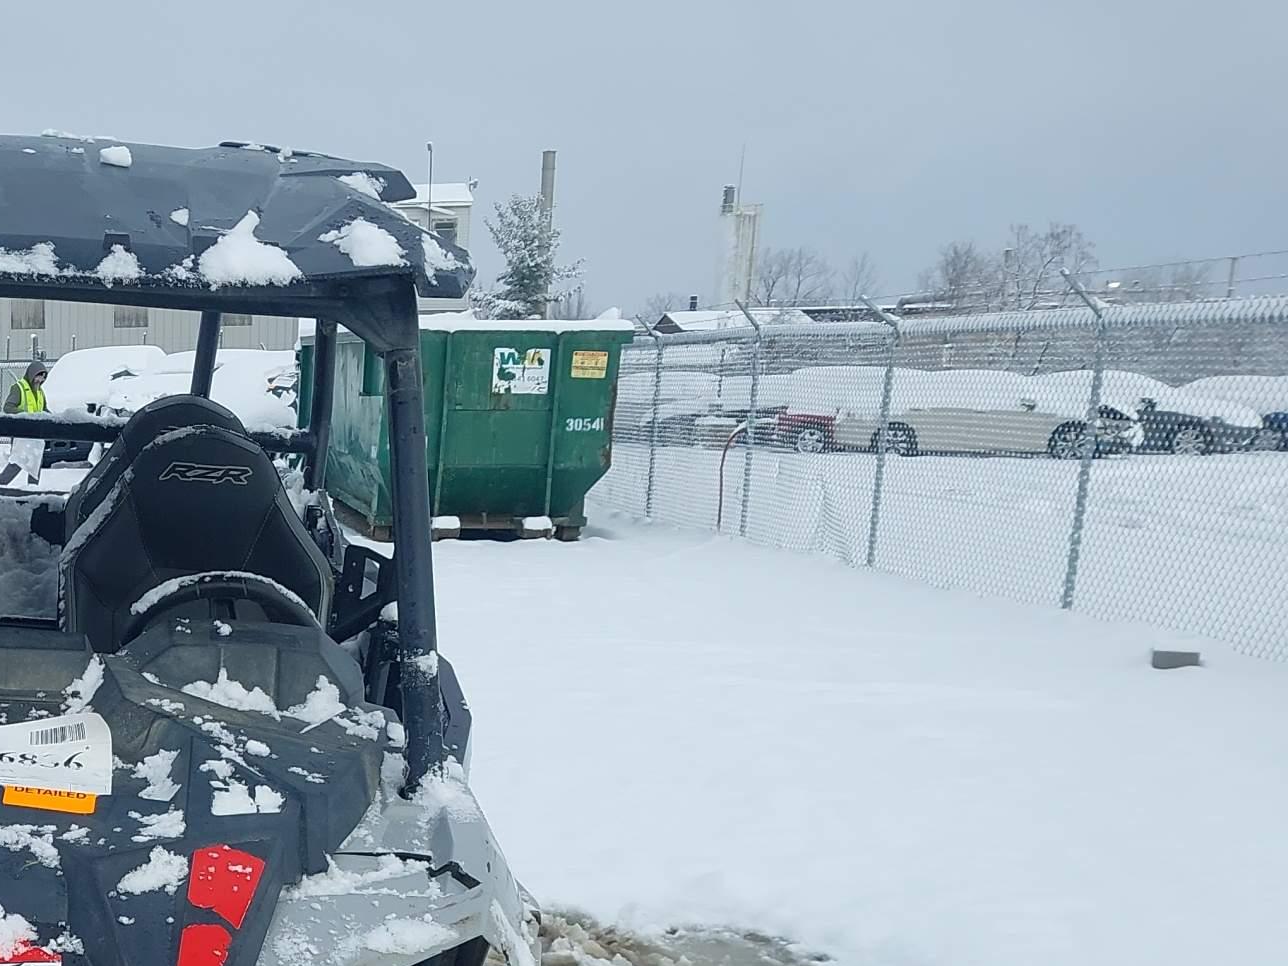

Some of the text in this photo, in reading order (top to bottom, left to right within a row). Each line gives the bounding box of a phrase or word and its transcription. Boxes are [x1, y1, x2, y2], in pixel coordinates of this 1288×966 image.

[566, 417, 604, 431] 30541
[159, 462, 252, 485] RZR
[14, 785, 87, 799] DETAILED
